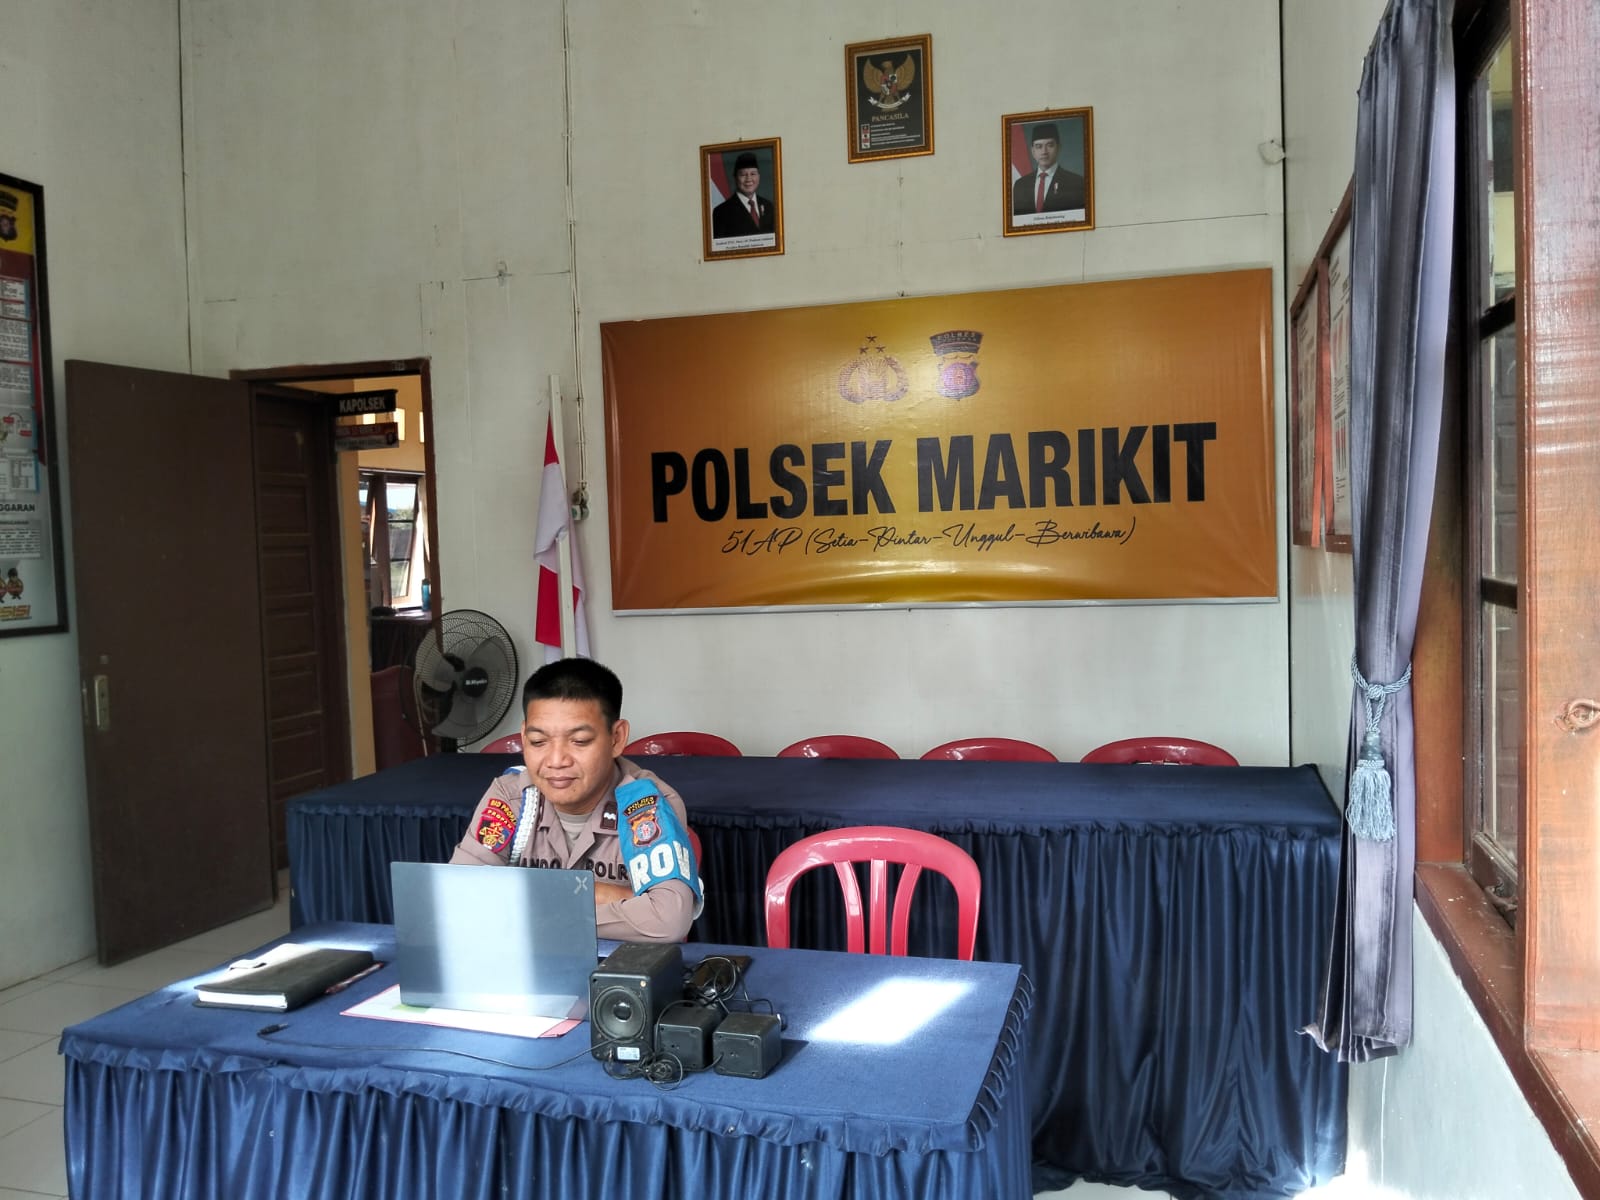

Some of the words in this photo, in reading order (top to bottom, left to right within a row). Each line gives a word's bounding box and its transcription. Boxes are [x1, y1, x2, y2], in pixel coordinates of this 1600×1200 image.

[339, 396, 386, 413] KAPOLSEK
[650, 439, 897, 523] POLSEK
[916, 422, 1217, 513] MARIKIT
[585, 858, 629, 881] POLR
[629, 841, 691, 892] ROV
